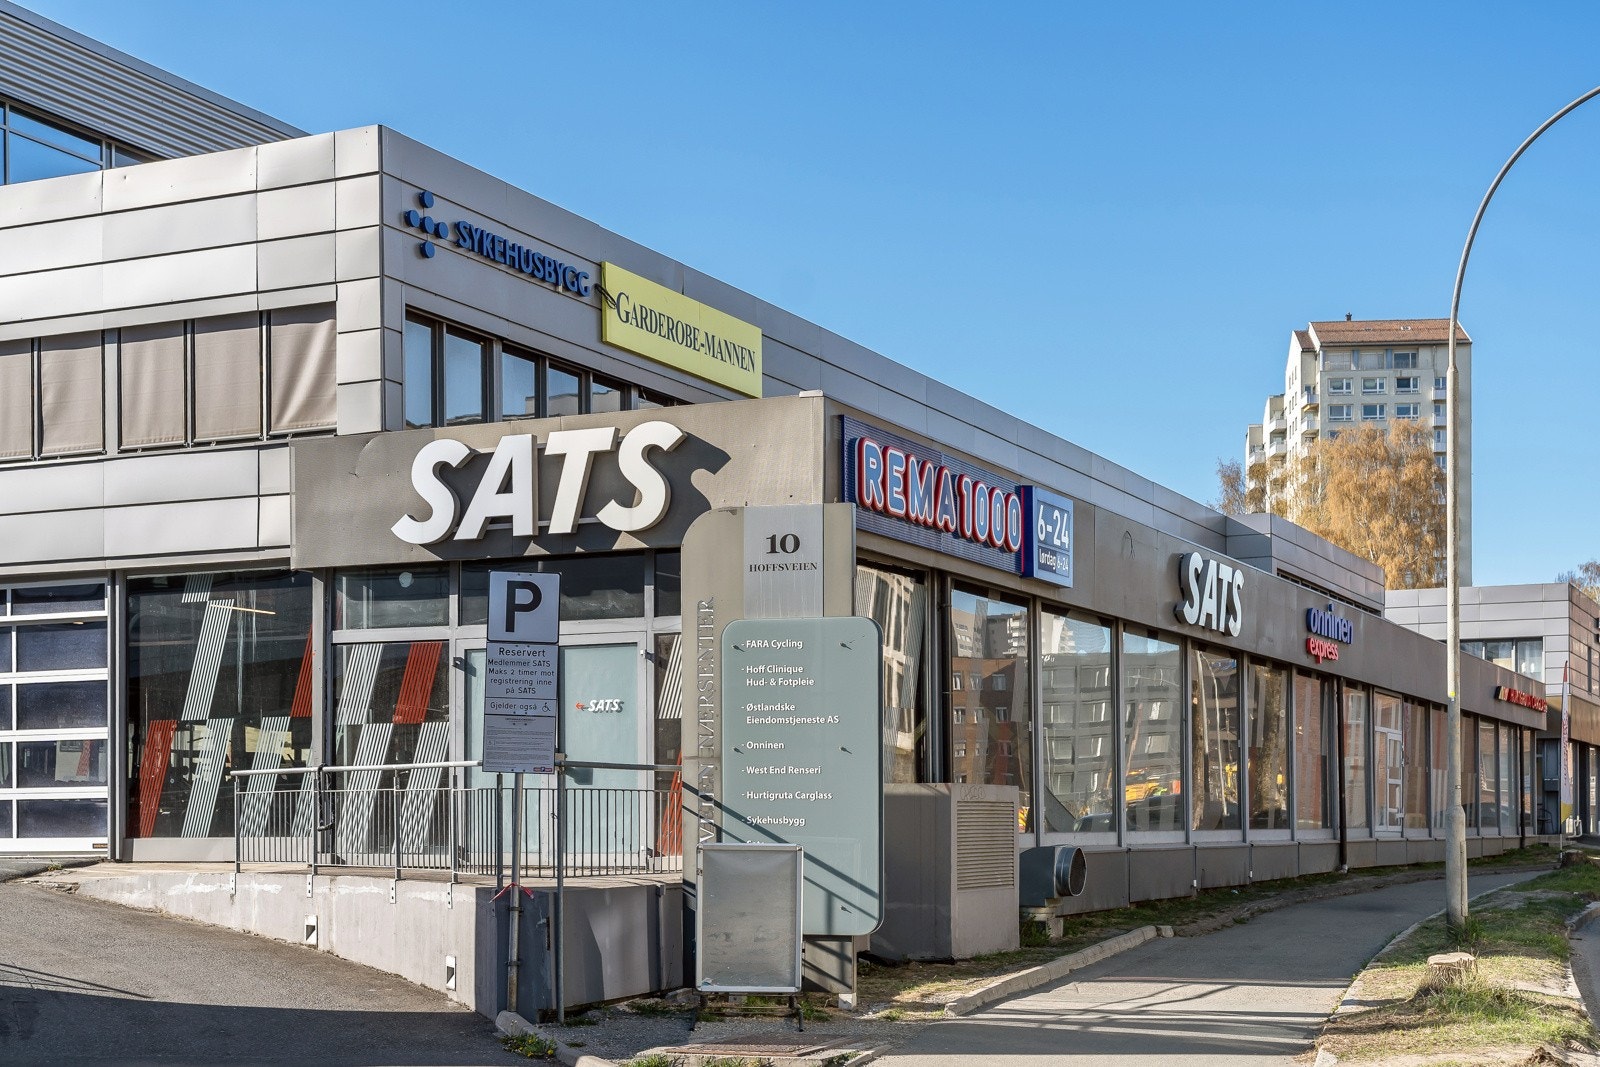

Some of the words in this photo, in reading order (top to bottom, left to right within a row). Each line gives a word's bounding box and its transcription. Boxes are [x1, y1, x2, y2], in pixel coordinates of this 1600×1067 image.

[455, 219, 591, 297] SYKEHUSBYGG
[615, 291, 756, 374] GARDEROBE-MANNEN
[391, 420, 687, 545] SATS
[765, 533, 801, 555] 10
[749, 562, 818, 573] HOFFSVEIEN
[1180, 551, 1245, 638] SATS
[505, 580, 543, 633] P
[1307, 603, 1354, 645] onninen
[746, 639, 769, 648] FARA
[771, 639, 803, 650] Cycling
[498, 647, 546, 657] Reservert
[1307, 637, 1339, 664] express
[487, 658, 531, 667] Medlemmer
[532, 660, 551, 668] SATS
[488, 667, 508, 675] Maks
[746, 665, 766, 674] Hoff
[767, 665, 804, 676] Clinique
[490, 677, 534, 687] registrering
[746, 677, 768, 687] Hud-
[770, 678, 777, 687] &
[778, 677, 815, 688] Fotpleie
[505, 686, 515, 695] på
[518, 687, 536, 695] SATS
[490, 702, 517, 711] Gjelder
[519, 703, 538, 711] også
[587, 698, 620, 712] SATS
[746, 702, 796, 712] Østlandske
[746, 715, 826, 726] Eiendomstjeneste
[827, 716, 840, 724] AS
[746, 741, 785, 750] Onninen
[746, 766, 768, 775] West
[769, 766, 787, 775] End
[788, 766, 821, 775] Renseri
[746, 790, 794, 802] Hurtigruta
[795, 790, 833, 802] Carglass
[746, 816, 806, 827] Sykehusbygg
